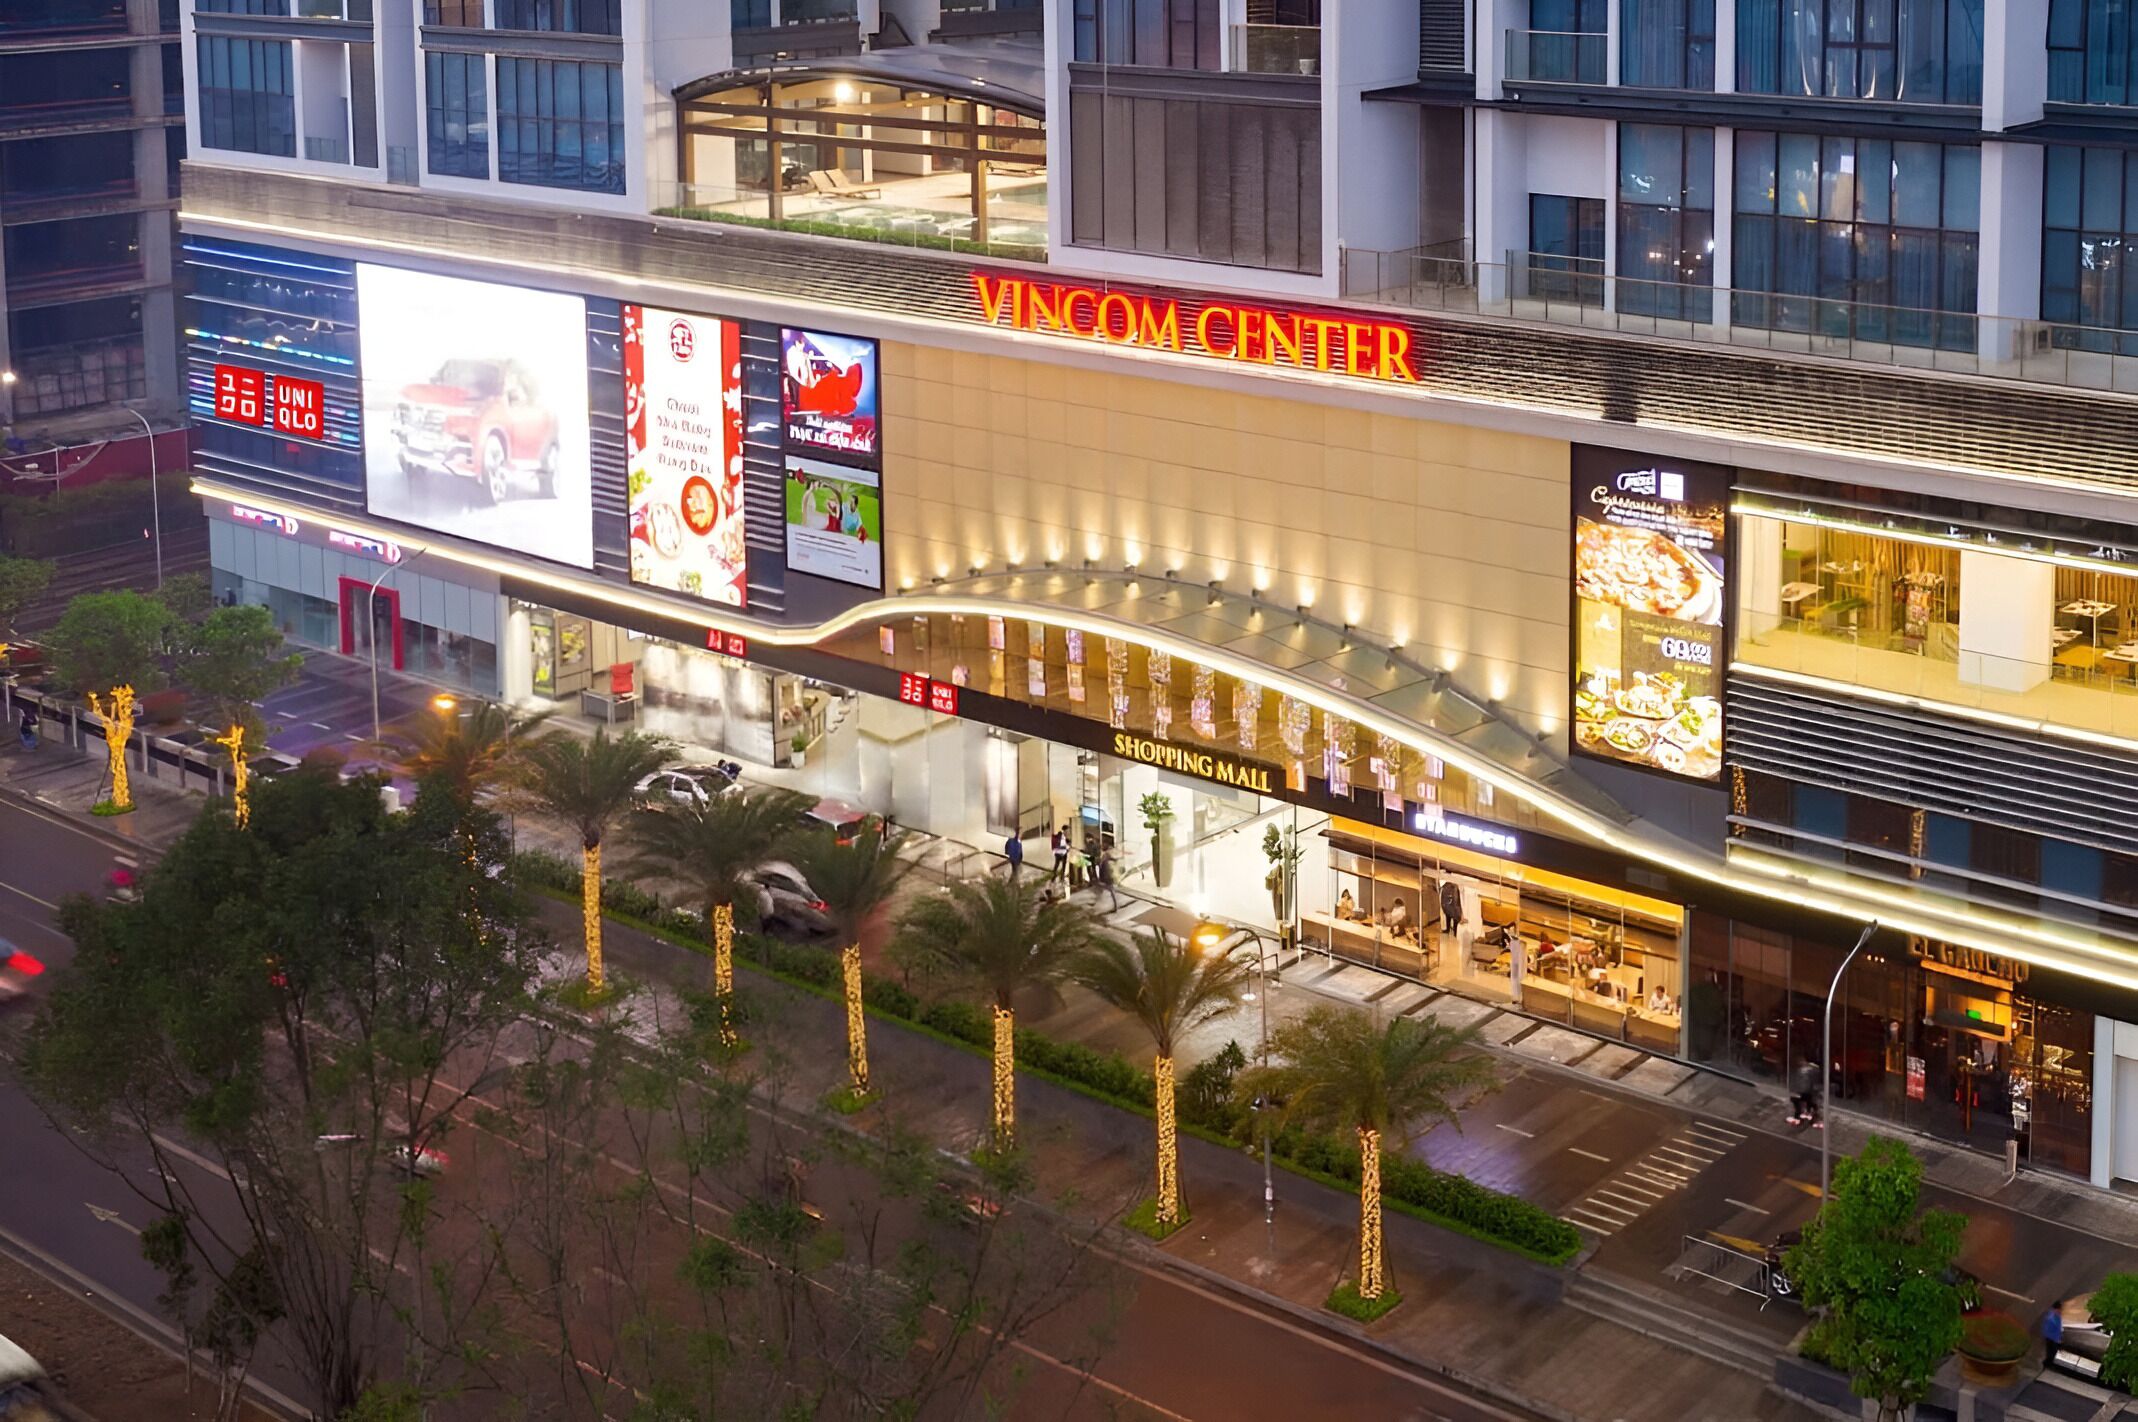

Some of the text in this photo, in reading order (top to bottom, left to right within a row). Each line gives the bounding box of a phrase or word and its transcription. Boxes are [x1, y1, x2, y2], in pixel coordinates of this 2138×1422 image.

[971, 275, 1421, 384] VINCOM CENTER
[279, 384, 313, 410] UNI
[279, 407, 317, 431] QLO
[1114, 733, 1273, 793] SHOPPING MALL
